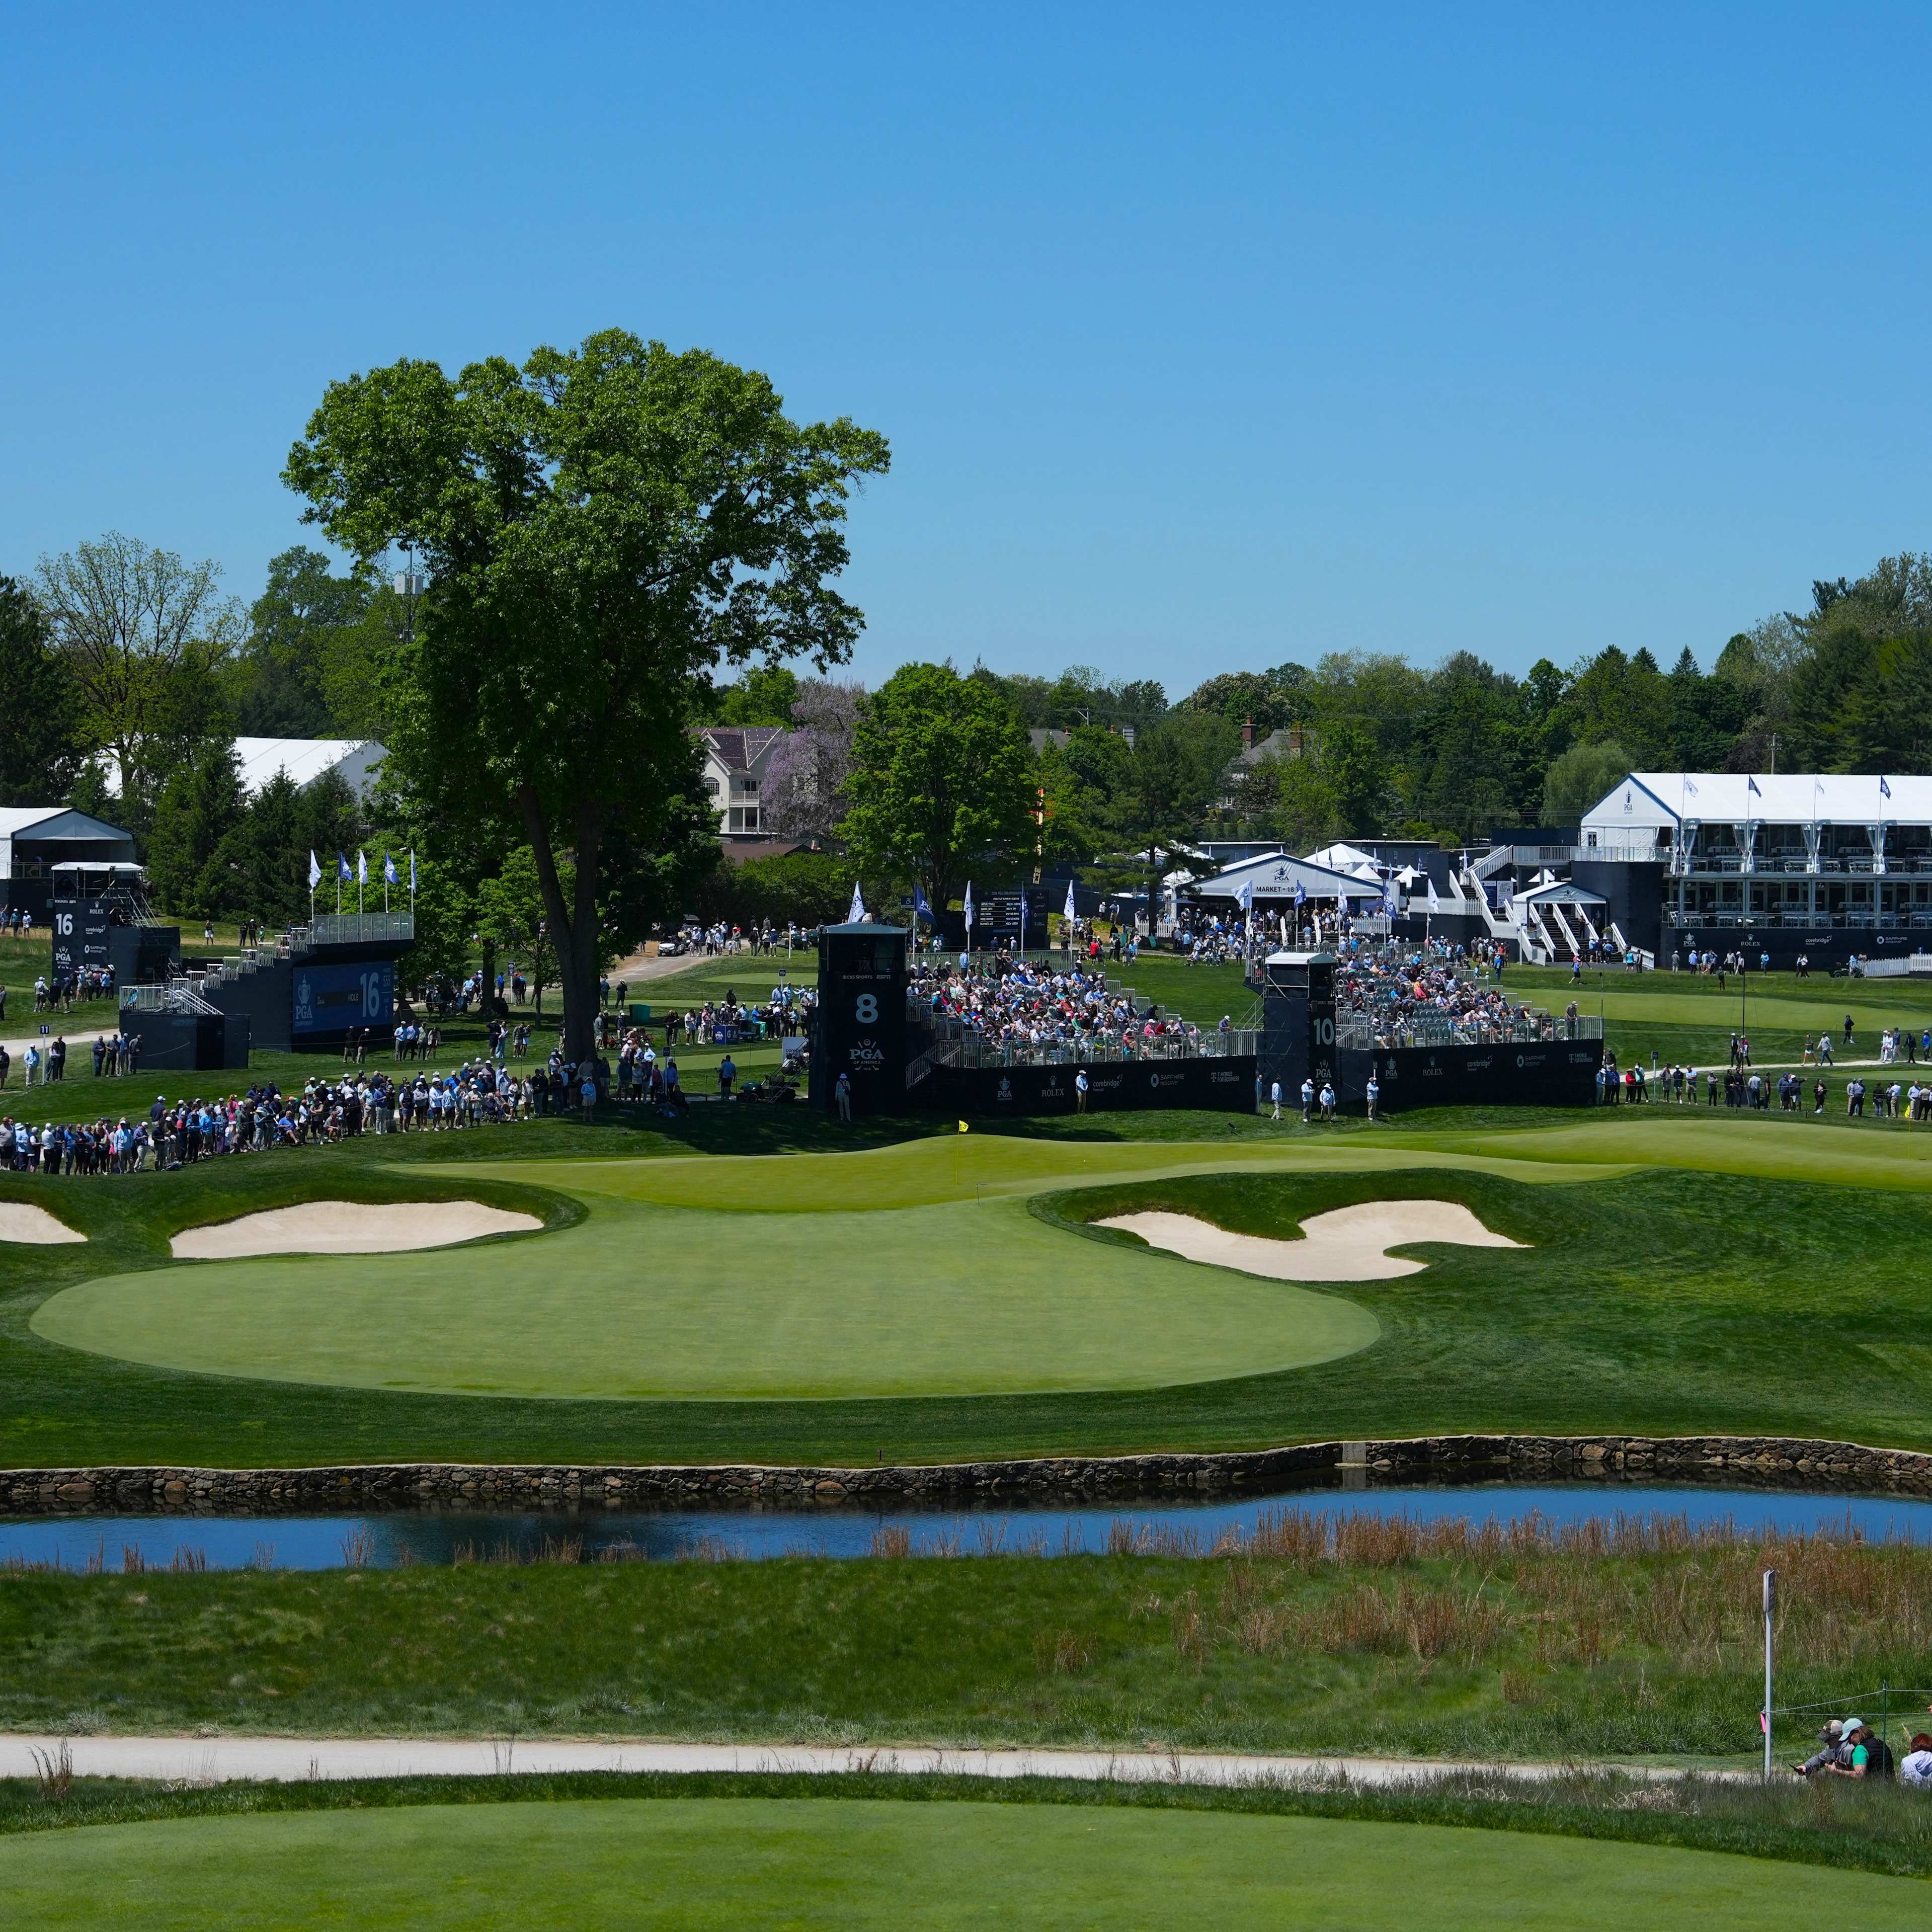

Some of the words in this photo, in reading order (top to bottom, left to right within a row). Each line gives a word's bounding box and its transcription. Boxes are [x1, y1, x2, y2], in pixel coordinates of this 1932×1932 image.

[55, 913, 73, 935] 16
[55, 953, 71, 961] PGA
[383, 975, 391, 987] 555
[348, 993, 359, 1002] HOLE
[360, 972, 380, 1017] 16
[295, 1005, 313, 1019] PGA
[856, 994, 878, 1023] 8
[1313, 1018, 1334, 1045] 10
[849, 1049, 884, 1059] PGA
[1467, 1059, 1490, 1068] corebridge
[1316, 1069, 1332, 1078] PGA
[1423, 1068, 1443, 1076] ROLEX
[1093, 1080, 1120, 1088] corebridge
[1042, 1088, 1065, 1097] ROLEX
